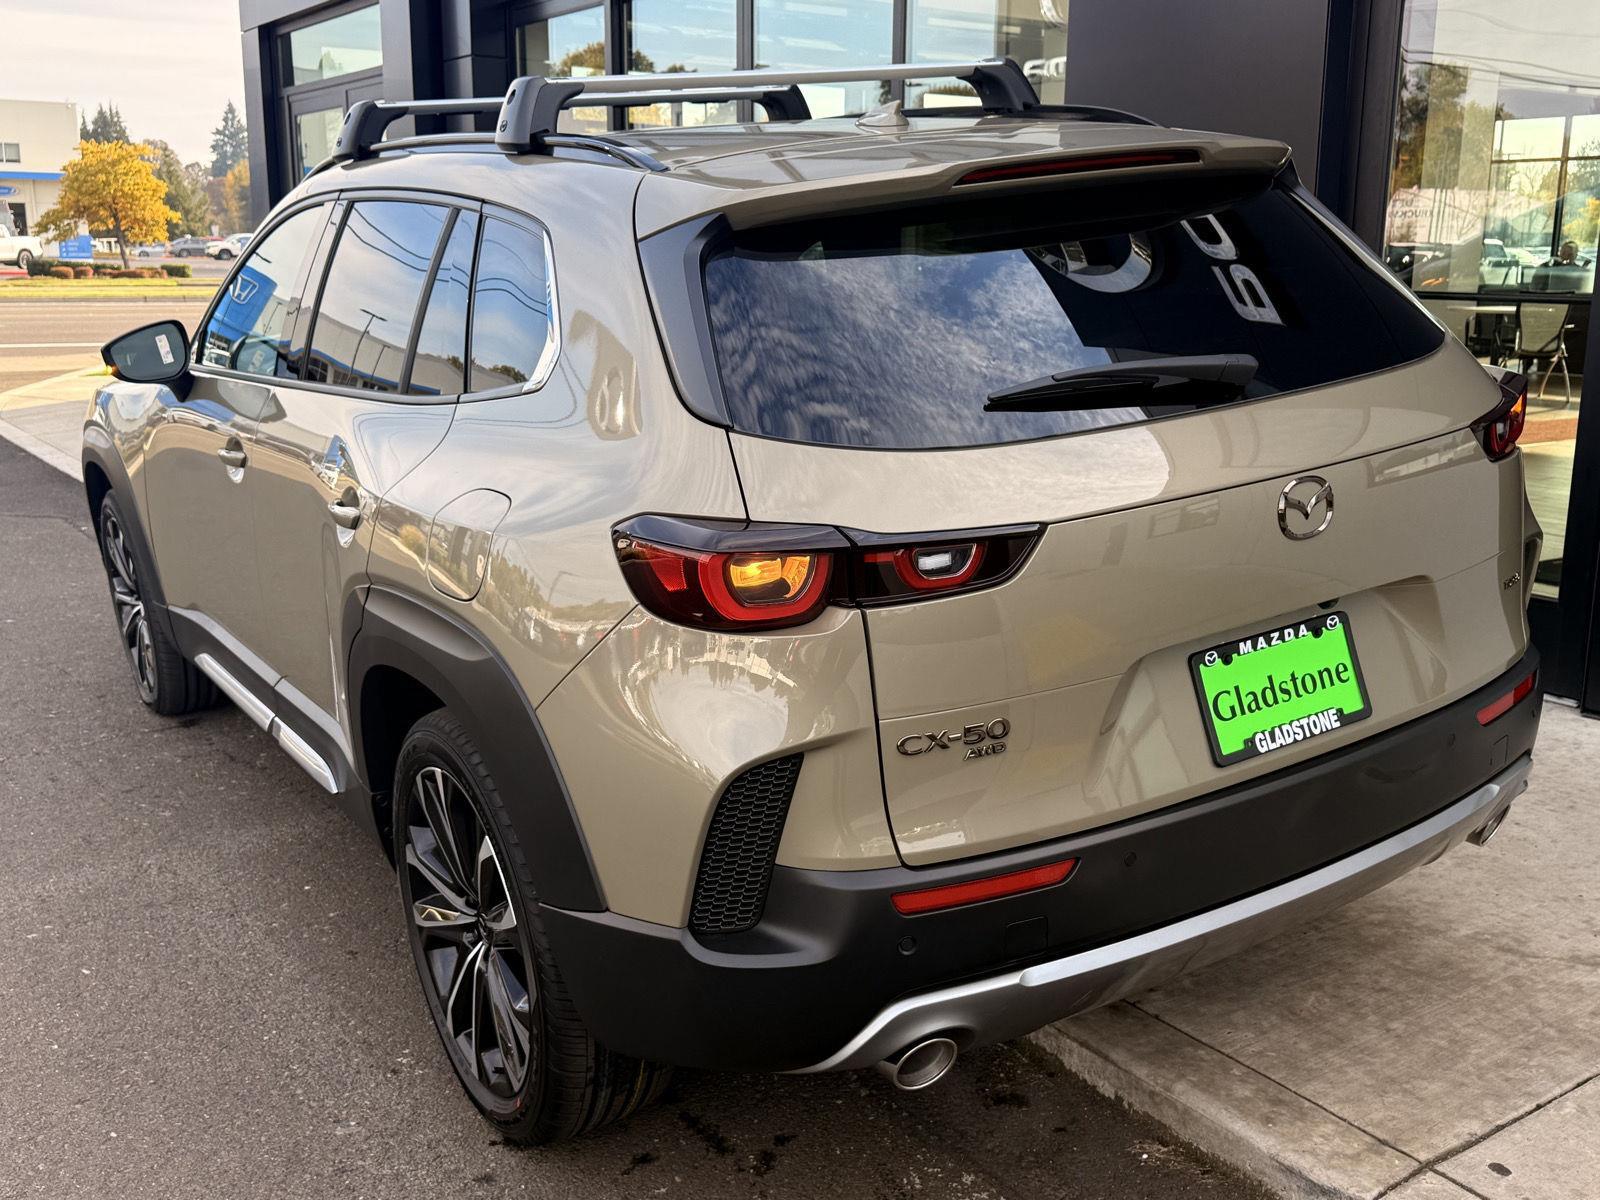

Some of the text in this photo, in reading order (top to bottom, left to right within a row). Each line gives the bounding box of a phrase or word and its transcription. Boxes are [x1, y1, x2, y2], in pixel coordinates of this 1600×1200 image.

[1239, 624, 1308, 655] MAZDA
[1212, 661, 1350, 722] Gladstone
[896, 717, 1011, 756] CX-50
[1254, 708, 1341, 754] GLADSTONE
[963, 741, 1007, 761] AWD
